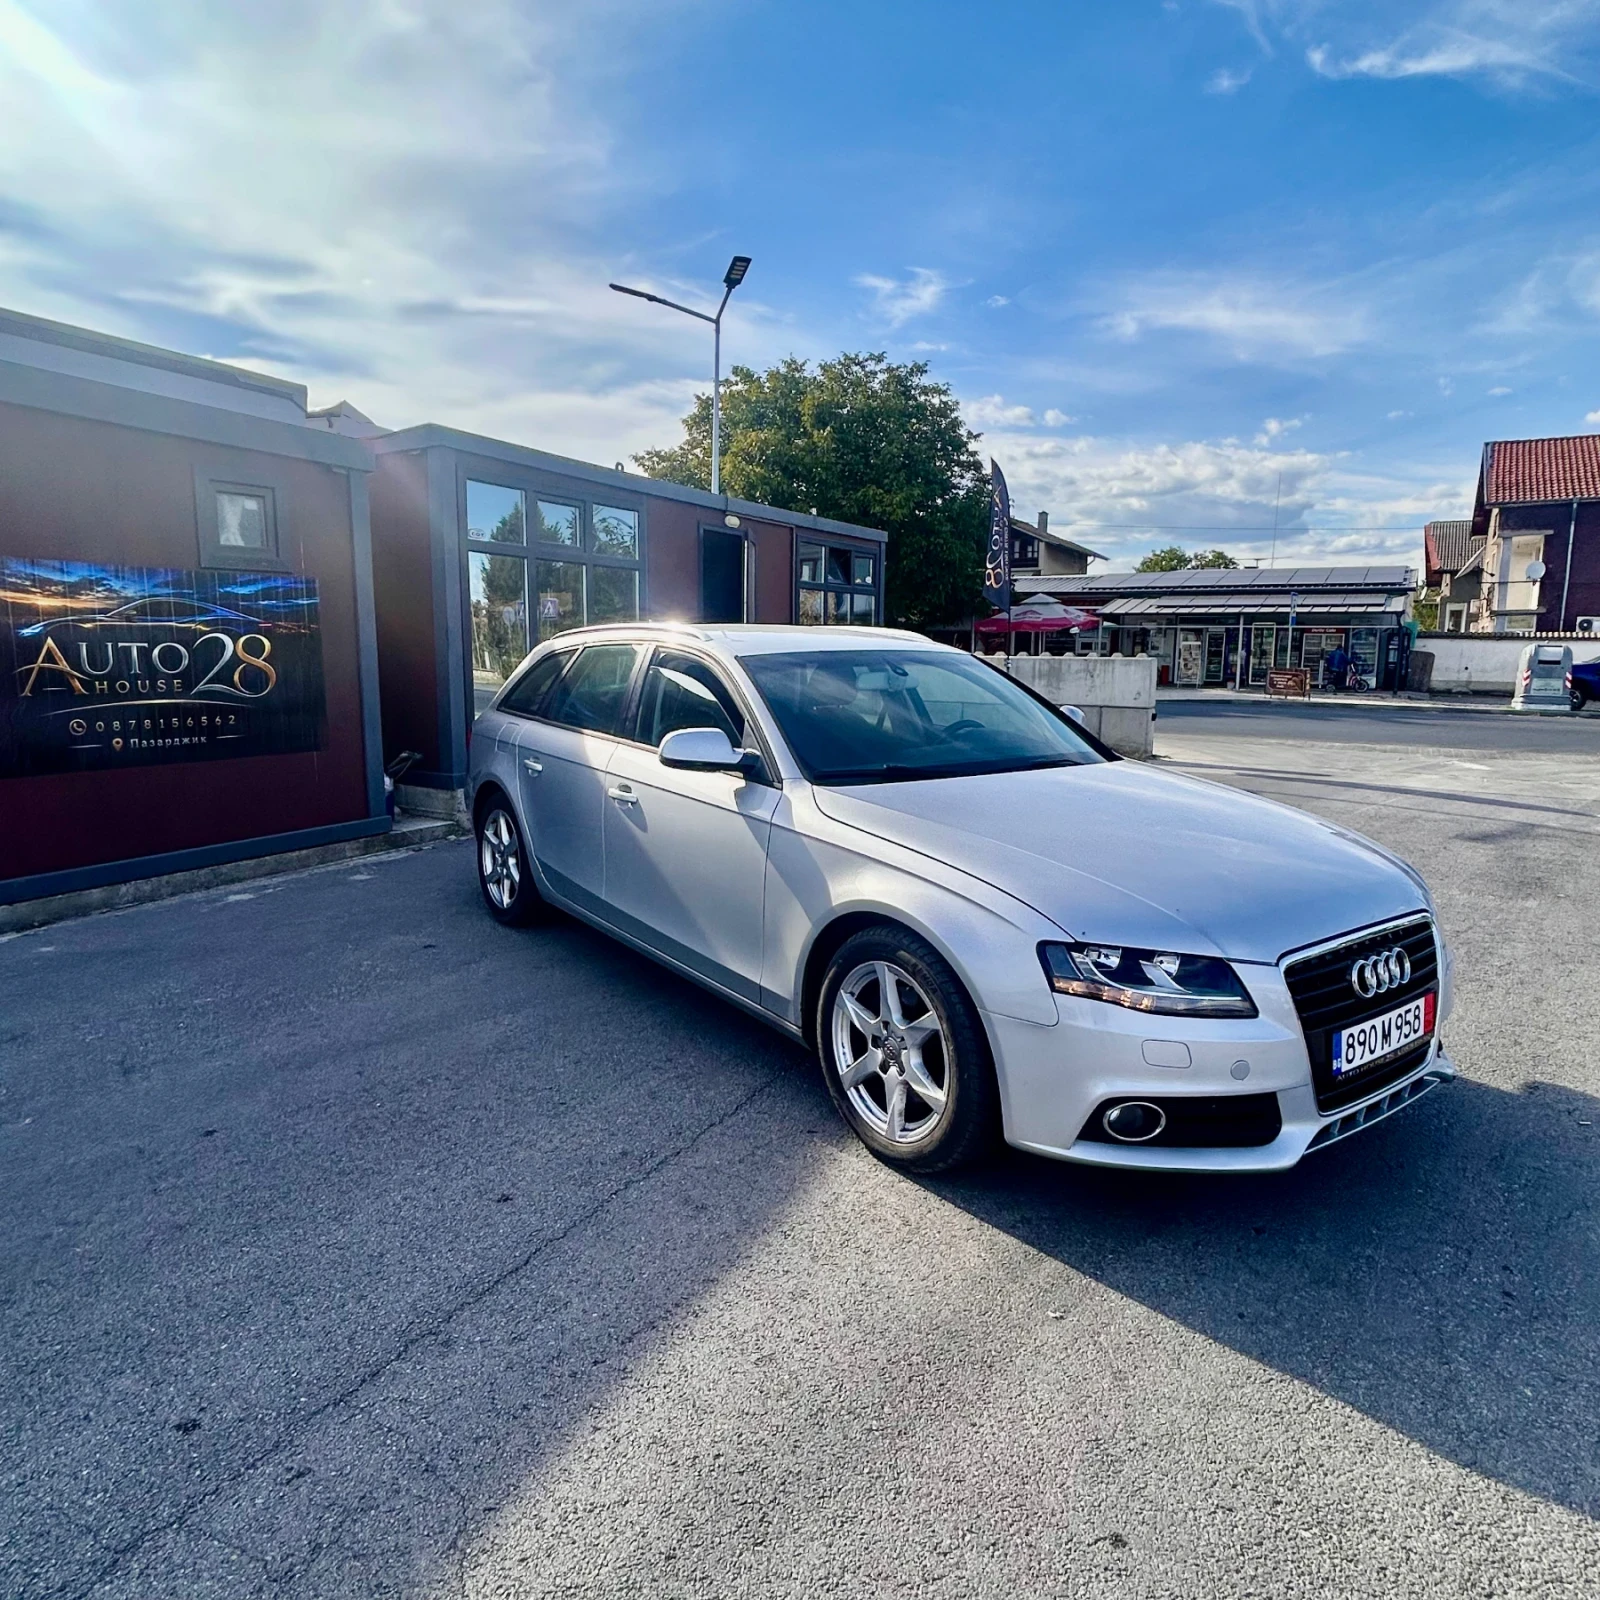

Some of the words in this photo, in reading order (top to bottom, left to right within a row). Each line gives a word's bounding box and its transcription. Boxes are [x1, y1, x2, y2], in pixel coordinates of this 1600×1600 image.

[95, 679, 184, 695] HOUSE
[130, 736, 207, 749] Пазарджик
[1332, 1057, 1342, 1071] BG
